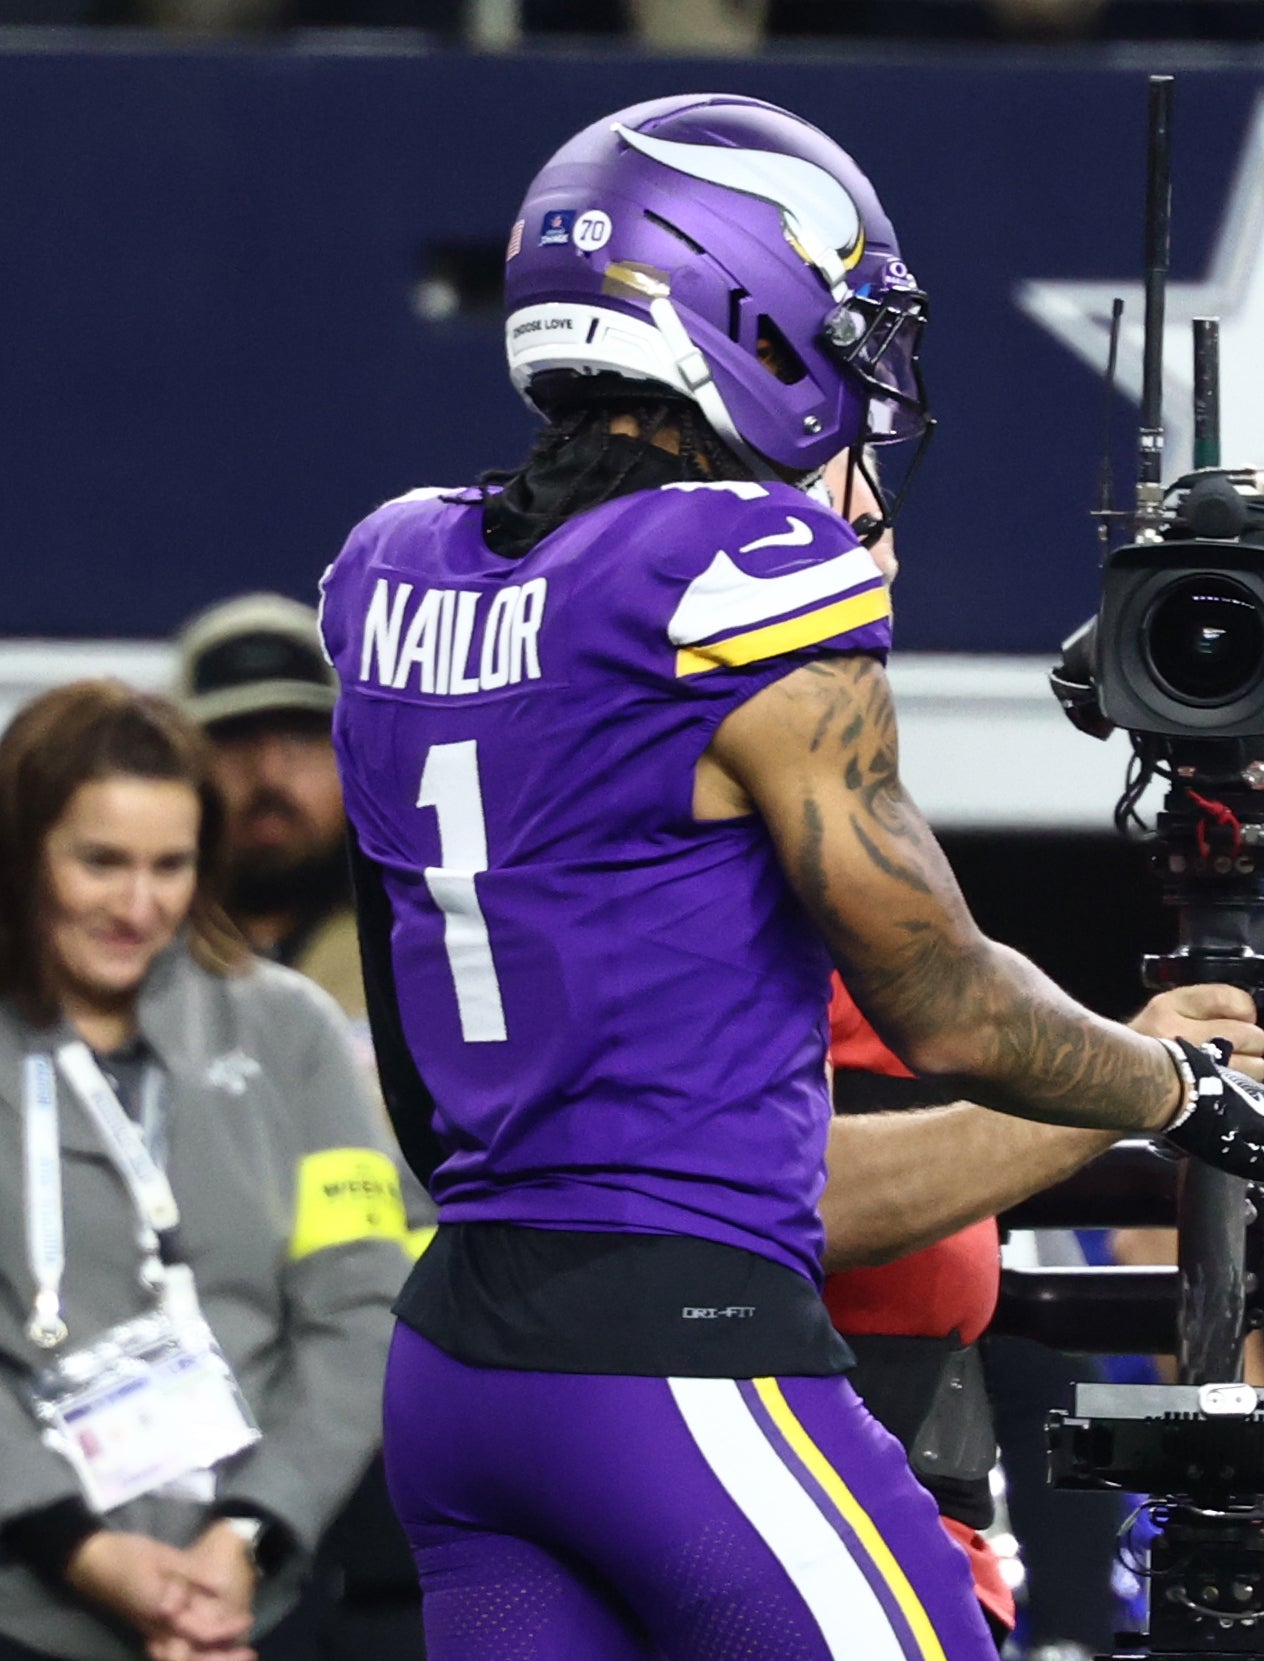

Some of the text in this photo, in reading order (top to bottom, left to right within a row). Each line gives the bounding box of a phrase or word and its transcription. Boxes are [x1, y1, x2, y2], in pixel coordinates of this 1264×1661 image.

[580, 219, 605, 242] 70
[544, 319, 574, 331] LOVE
[359, 577, 547, 696] NAILOR
[415, 738, 509, 1044] 1
[682, 1306, 757, 1319] DRI-FIT
